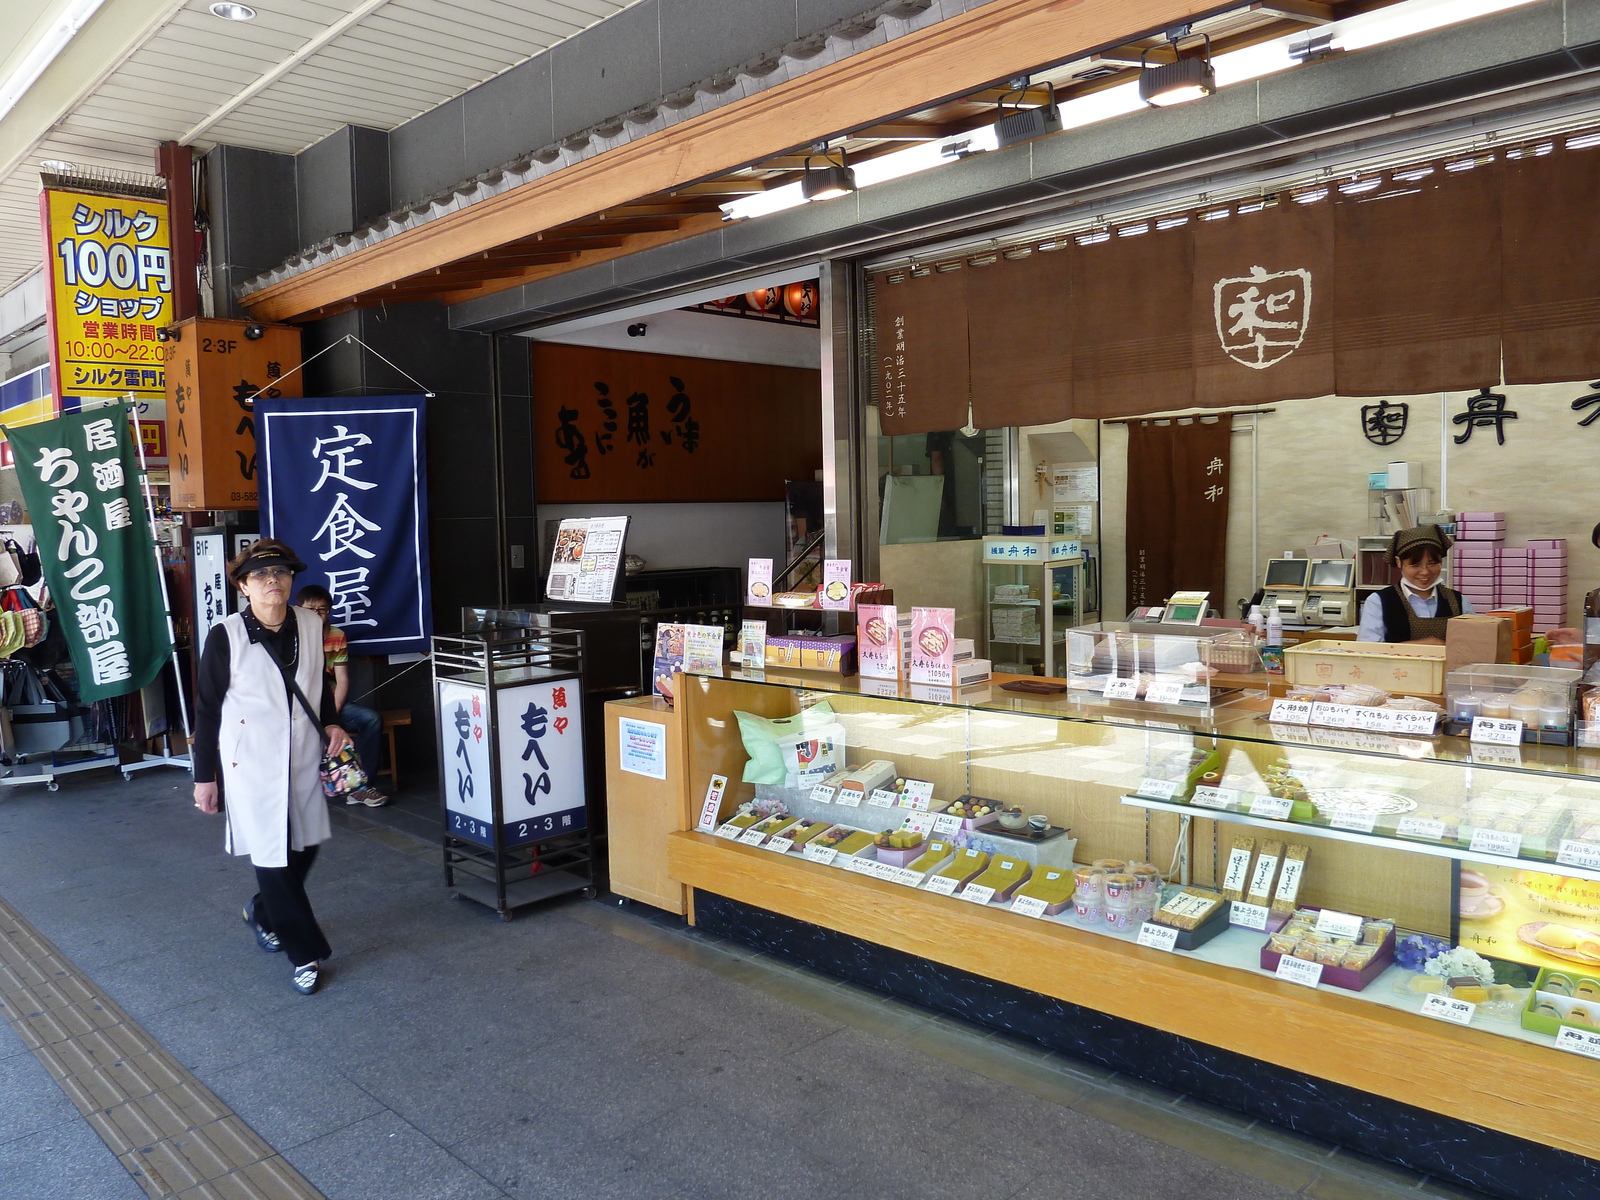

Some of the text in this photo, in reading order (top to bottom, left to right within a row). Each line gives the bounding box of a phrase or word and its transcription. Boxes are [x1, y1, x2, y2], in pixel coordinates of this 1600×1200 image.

[72, 202, 158, 242] シルク
[58, 238, 171, 293] 100円
[74, 290, 164, 320] ショップ
[83, 321, 156, 342] 営業時間
[895, 316, 906, 418] 創業明治三十五年
[175, 382, 190, 481] もへい
[83, 418, 133, 531] 居酒屋
[1204, 456, 1224, 502] 舟和
[195, 540, 208, 555] B1F
[310, 425, 382, 627] 定食屋
[1008, 545, 1037, 557] 舟和
[1061, 544, 1078, 556] 舟和
[33, 447, 132, 686] ちゃんこ部屋
[1276, 704, 1308, 713] 人形焼
[455, 702, 474, 803] もへい
[520, 702, 551, 805] もへい
